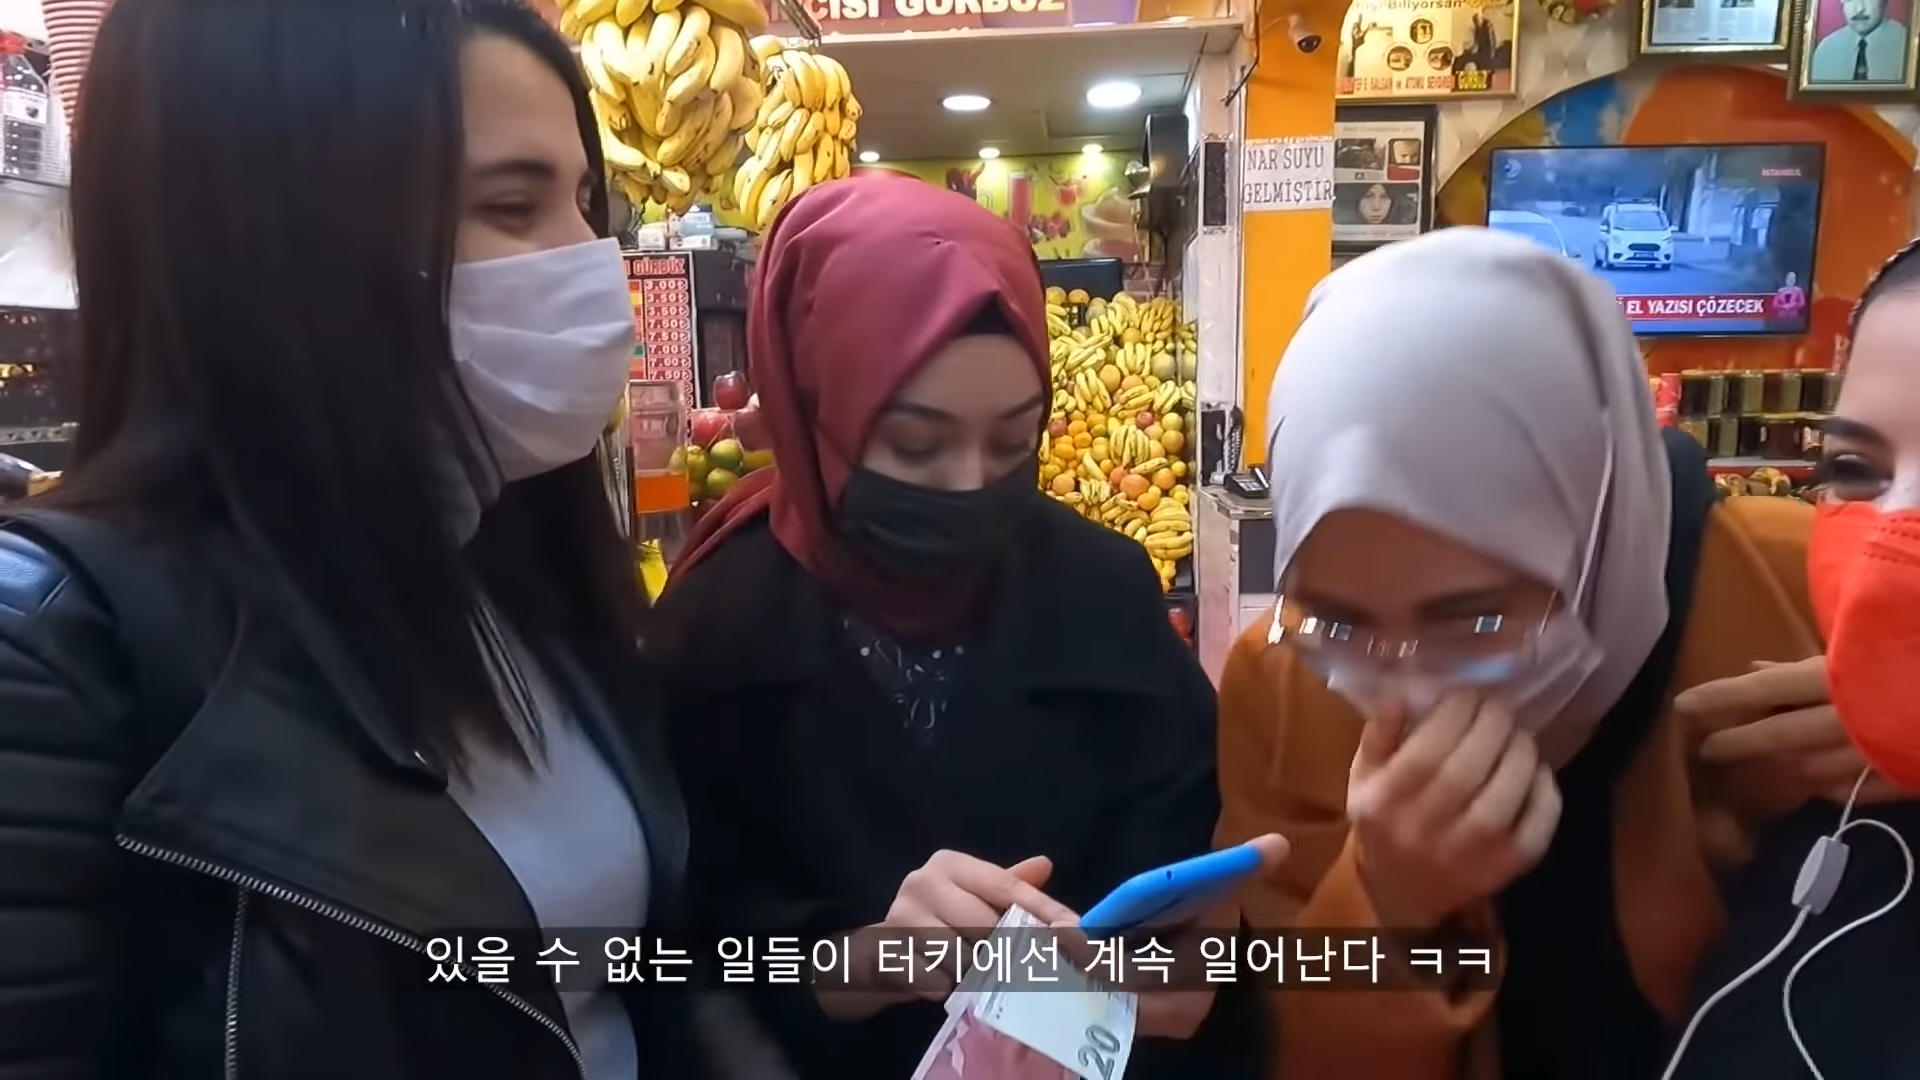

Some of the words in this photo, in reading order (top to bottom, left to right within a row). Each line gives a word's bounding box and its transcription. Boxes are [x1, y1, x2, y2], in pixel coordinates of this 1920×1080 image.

[1247, 149, 1278, 171] NAR
[1284, 147, 1324, 169] SUYU
[1243, 179, 1332, 205] GELMİŞTİR
[1626, 299, 1644, 314] EL
[1696, 296, 1764, 317] ÇÖZECEK
[1078, 1024, 1121, 1080] 20
